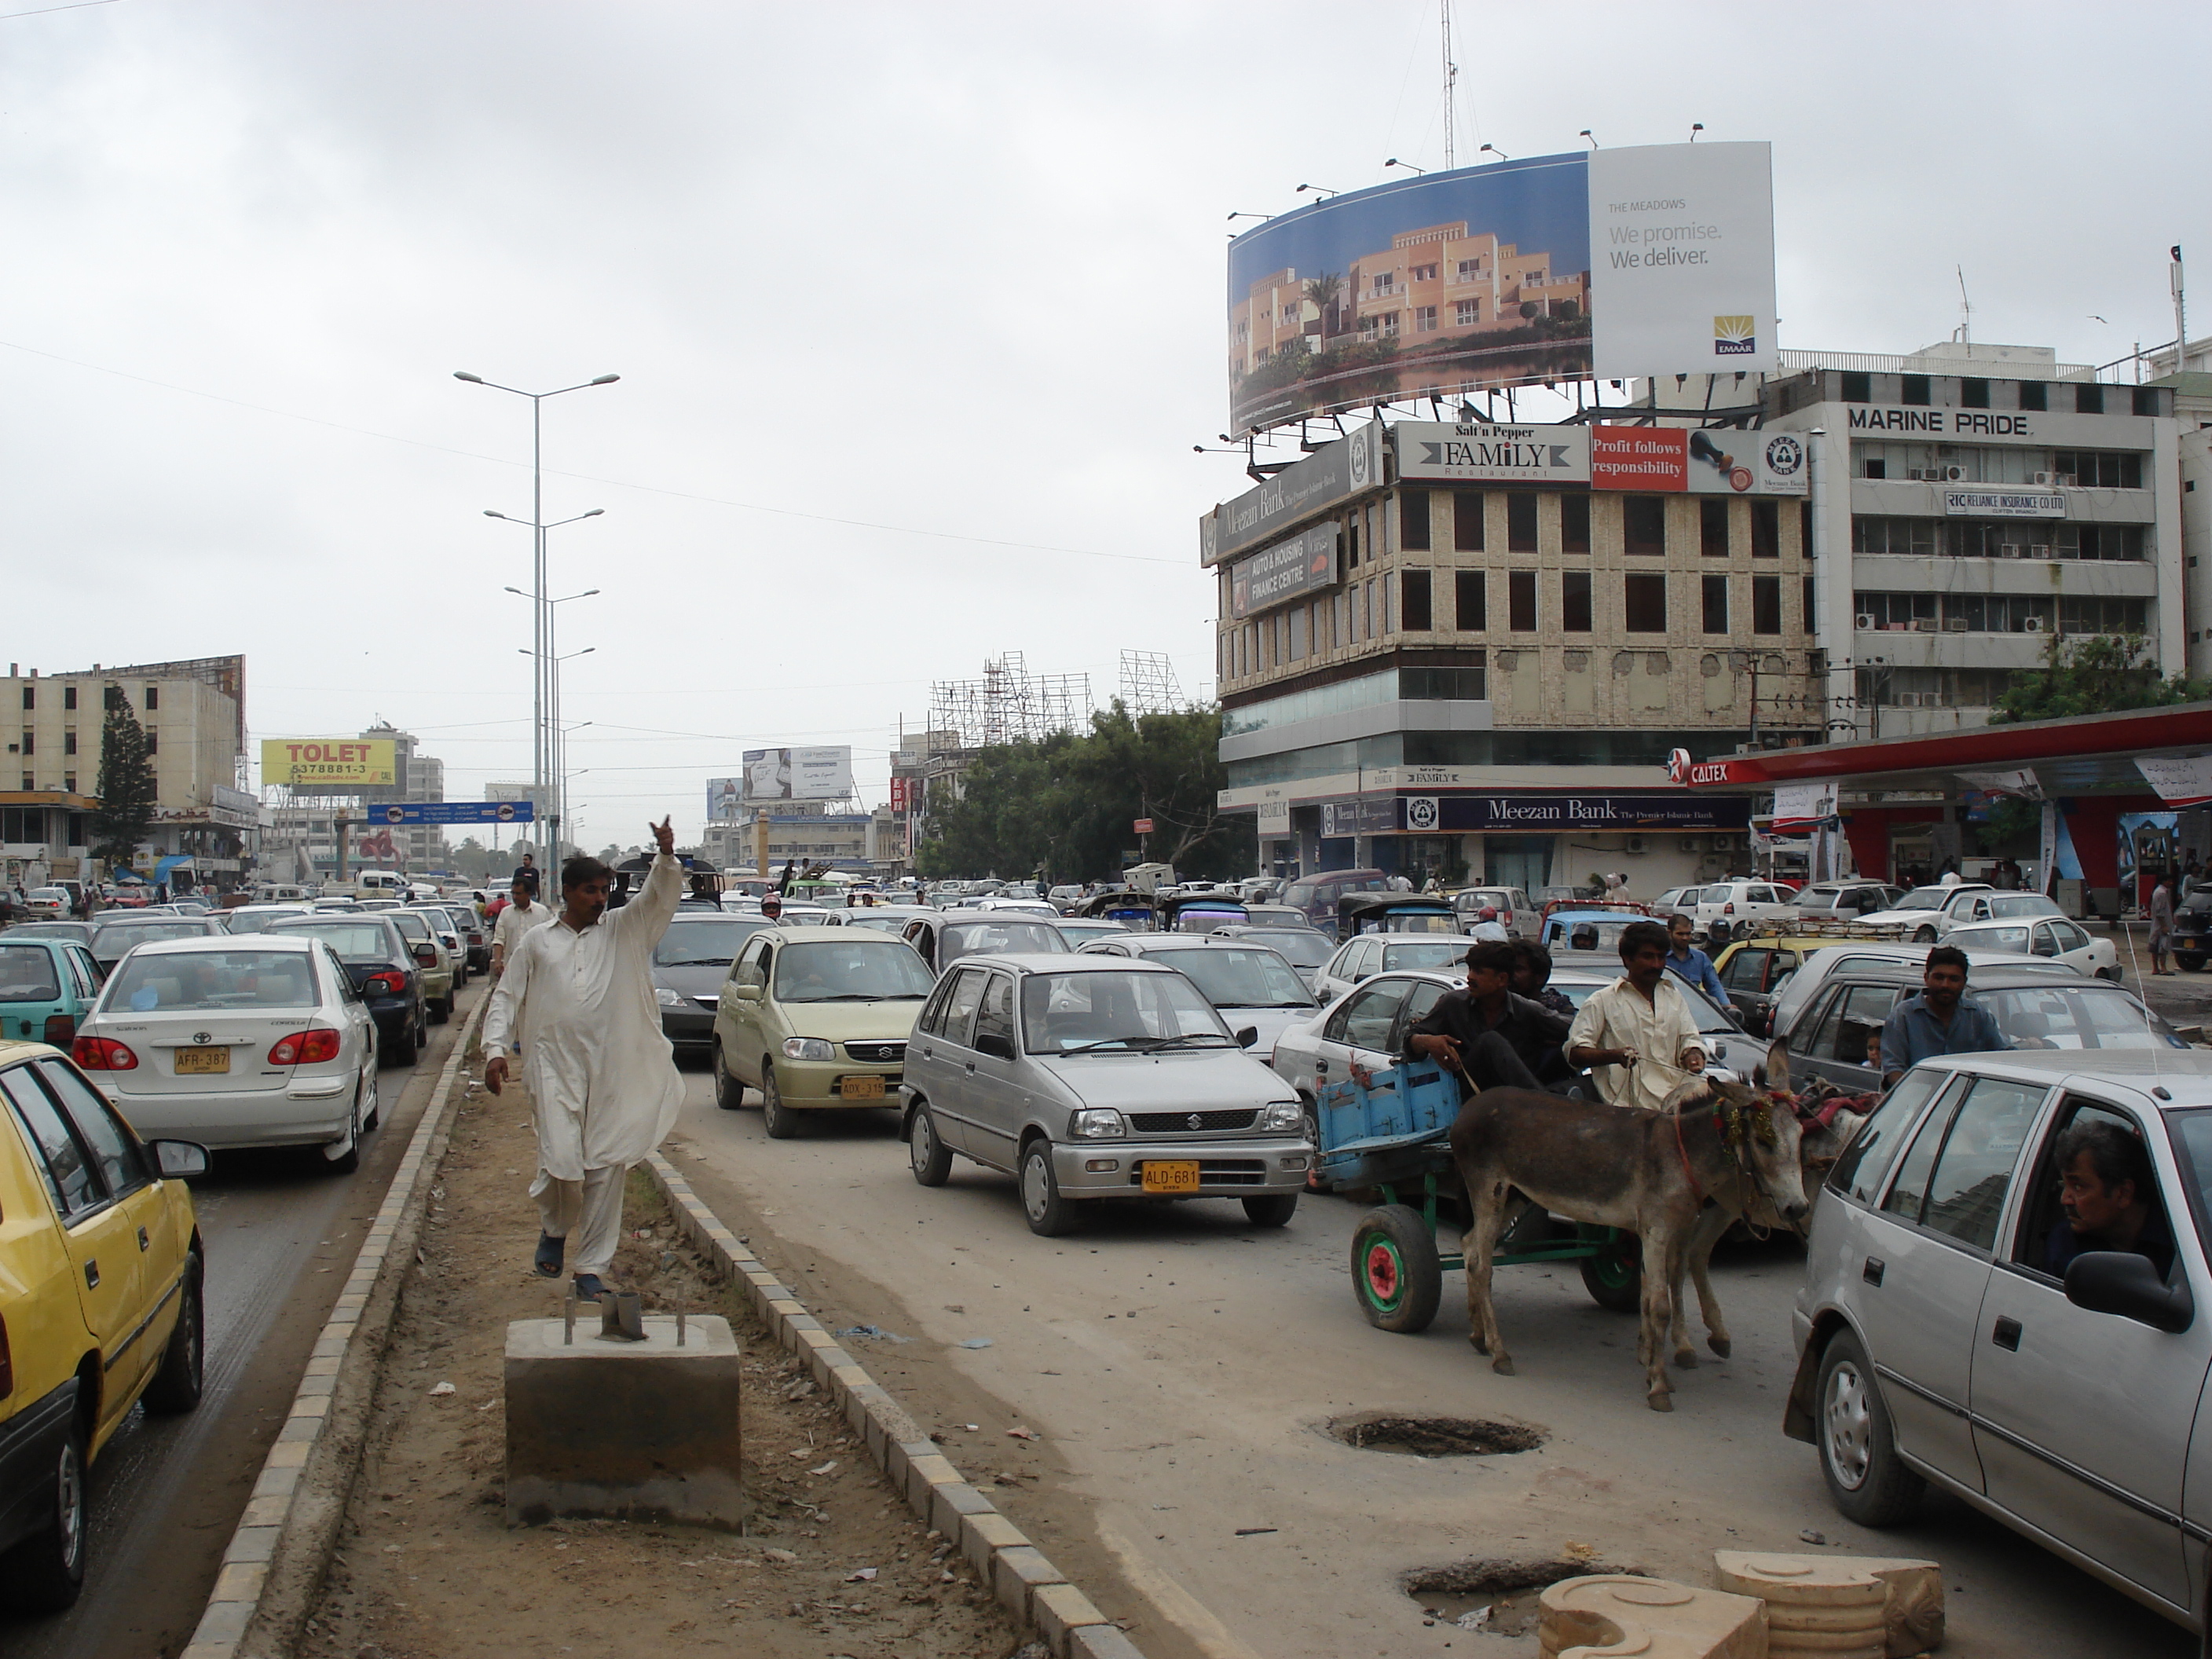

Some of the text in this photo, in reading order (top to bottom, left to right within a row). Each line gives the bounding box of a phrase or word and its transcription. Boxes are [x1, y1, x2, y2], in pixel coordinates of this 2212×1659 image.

[1609, 199, 1686, 213] THE MEADOWS
[1610, 222, 1723, 247] We promise.
[1610, 247, 1709, 269] We deliver.
[1849, 409, 2027, 435] MARINE PRIDE
[1493, 426, 1534, 440] Pepper
[1593, 438, 1682, 455] Profit follows
[1445, 467, 1547, 477] Restaurant
[1593, 460, 1683, 478] responsibility
[1225, 505, 1258, 537] Meezan
[1260, 479, 1286, 520] Bank
[1967, 495, 1998, 507] RELIANCE
[2001, 496, 2037, 508] INSURANCE
[1252, 556, 1269, 577] AUTO
[1269, 554, 1274, 569] &
[1275, 540, 1304, 567] HOUSING
[1252, 576, 1278, 601] FINANCE
[1278, 565, 1304, 590] CENTRE
[286, 745, 372, 762] TOLET
[291, 765, 366, 774] 5378881-3
[381, 771, 392, 781] CALL
[1691, 764, 1727, 783] CALTEX
[1489, 800, 1561, 819] Meezan
[1568, 800, 1617, 819] Bank
[1146, 1170, 1196, 1184] ALD-681
